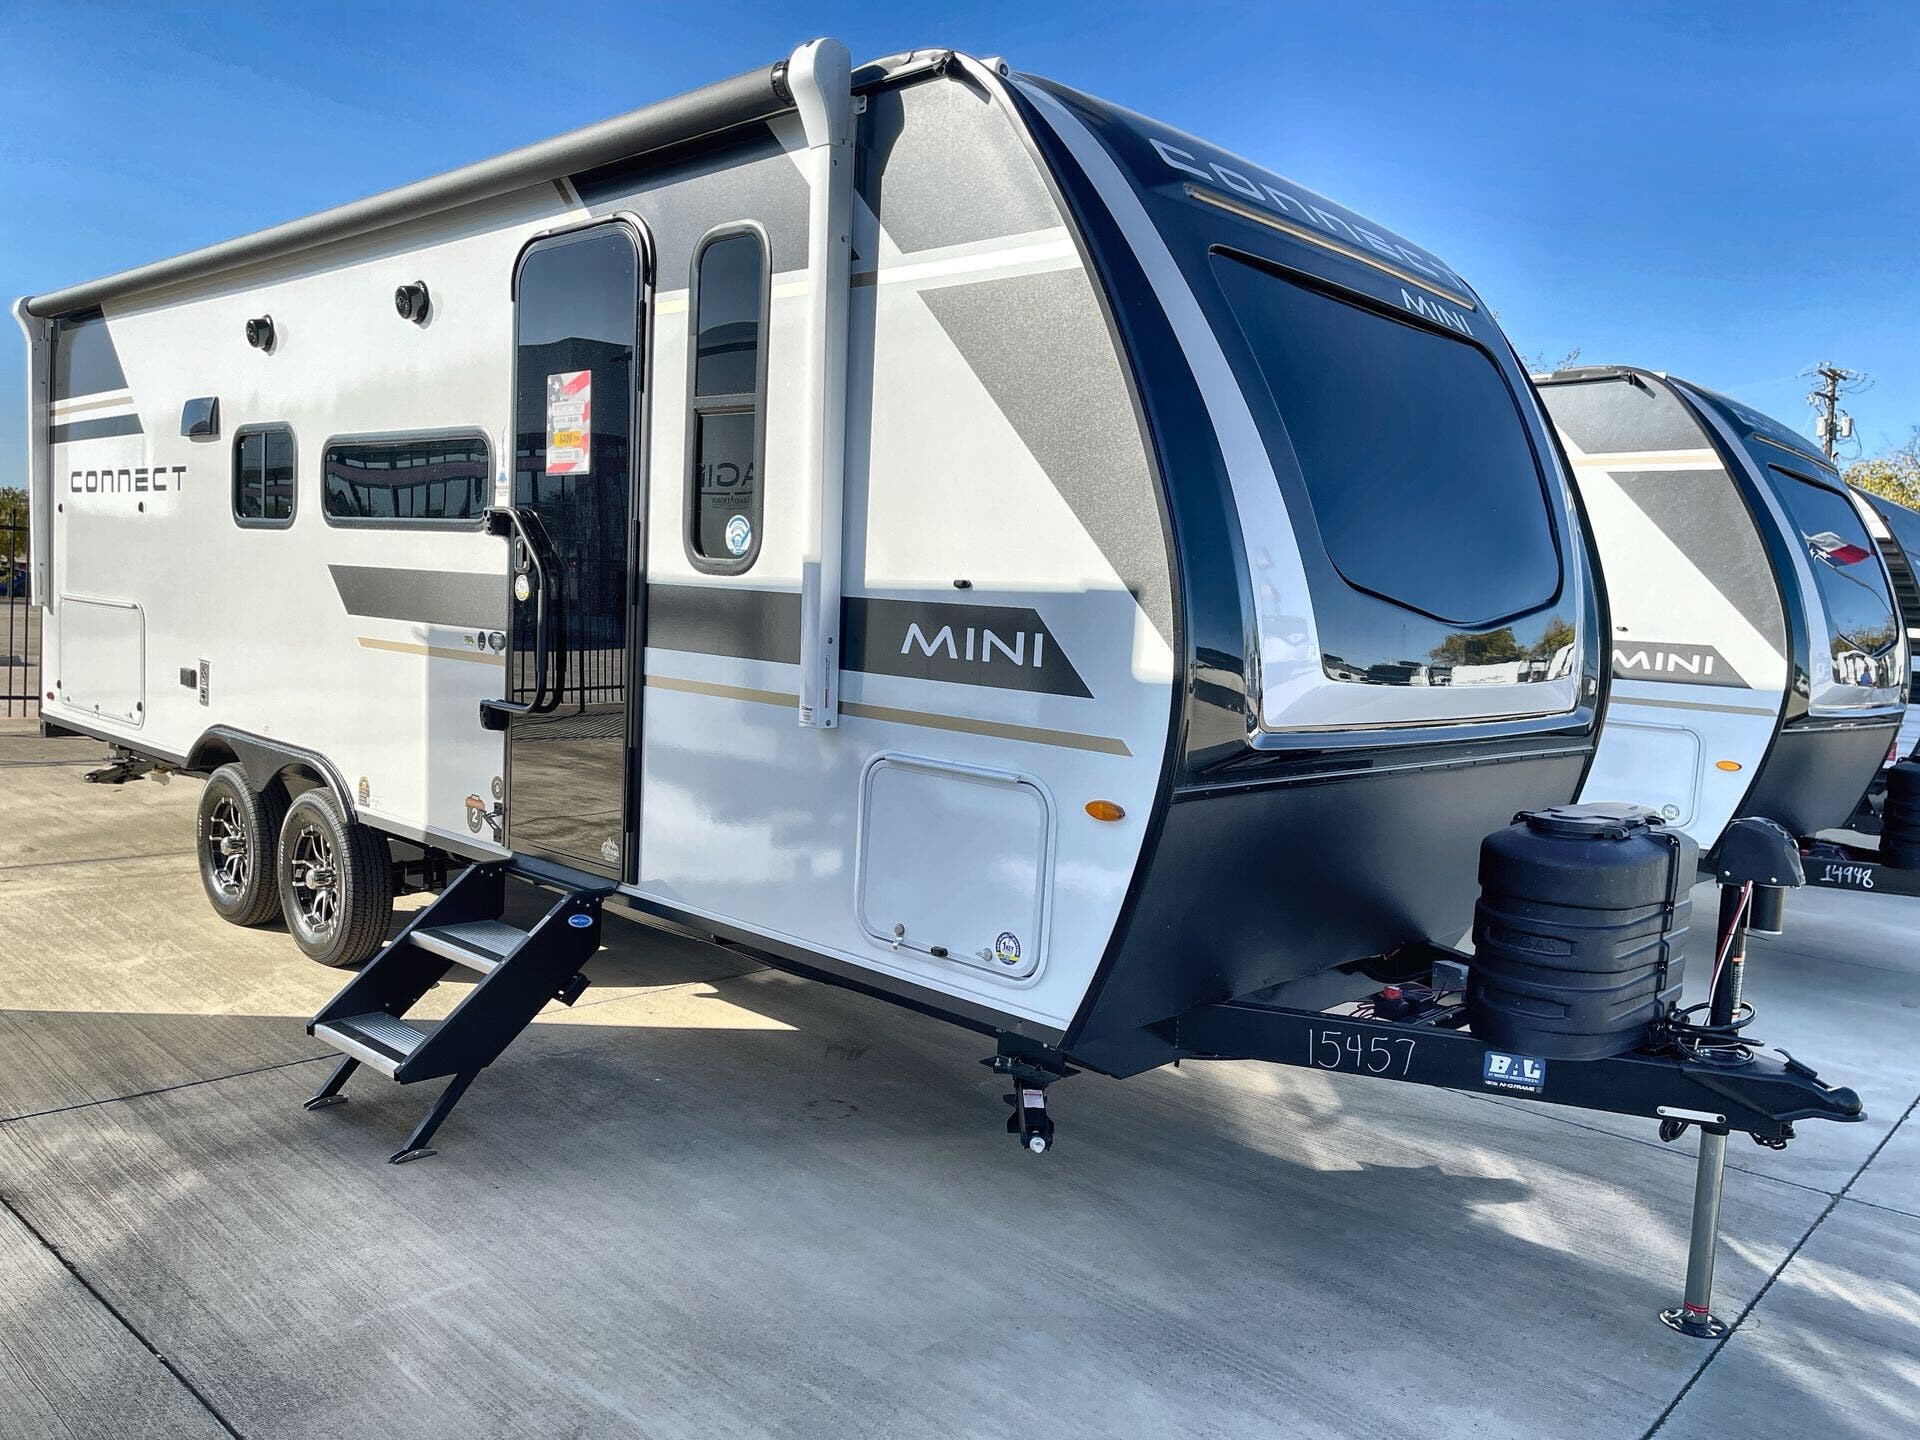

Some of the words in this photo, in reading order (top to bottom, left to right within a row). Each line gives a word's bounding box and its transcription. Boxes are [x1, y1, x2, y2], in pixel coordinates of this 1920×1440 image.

[1149, 137, 1465, 290] CONNECT
[1400, 287, 1474, 336] MINI
[70, 465, 187, 493] CONNECT
[900, 621, 1043, 668] MINI
[1612, 648, 1714, 675] MINI
[1819, 864, 1875, 889] 14948
[1308, 1028, 1416, 1076] 15457
[1489, 1054, 1541, 1078] BAL
